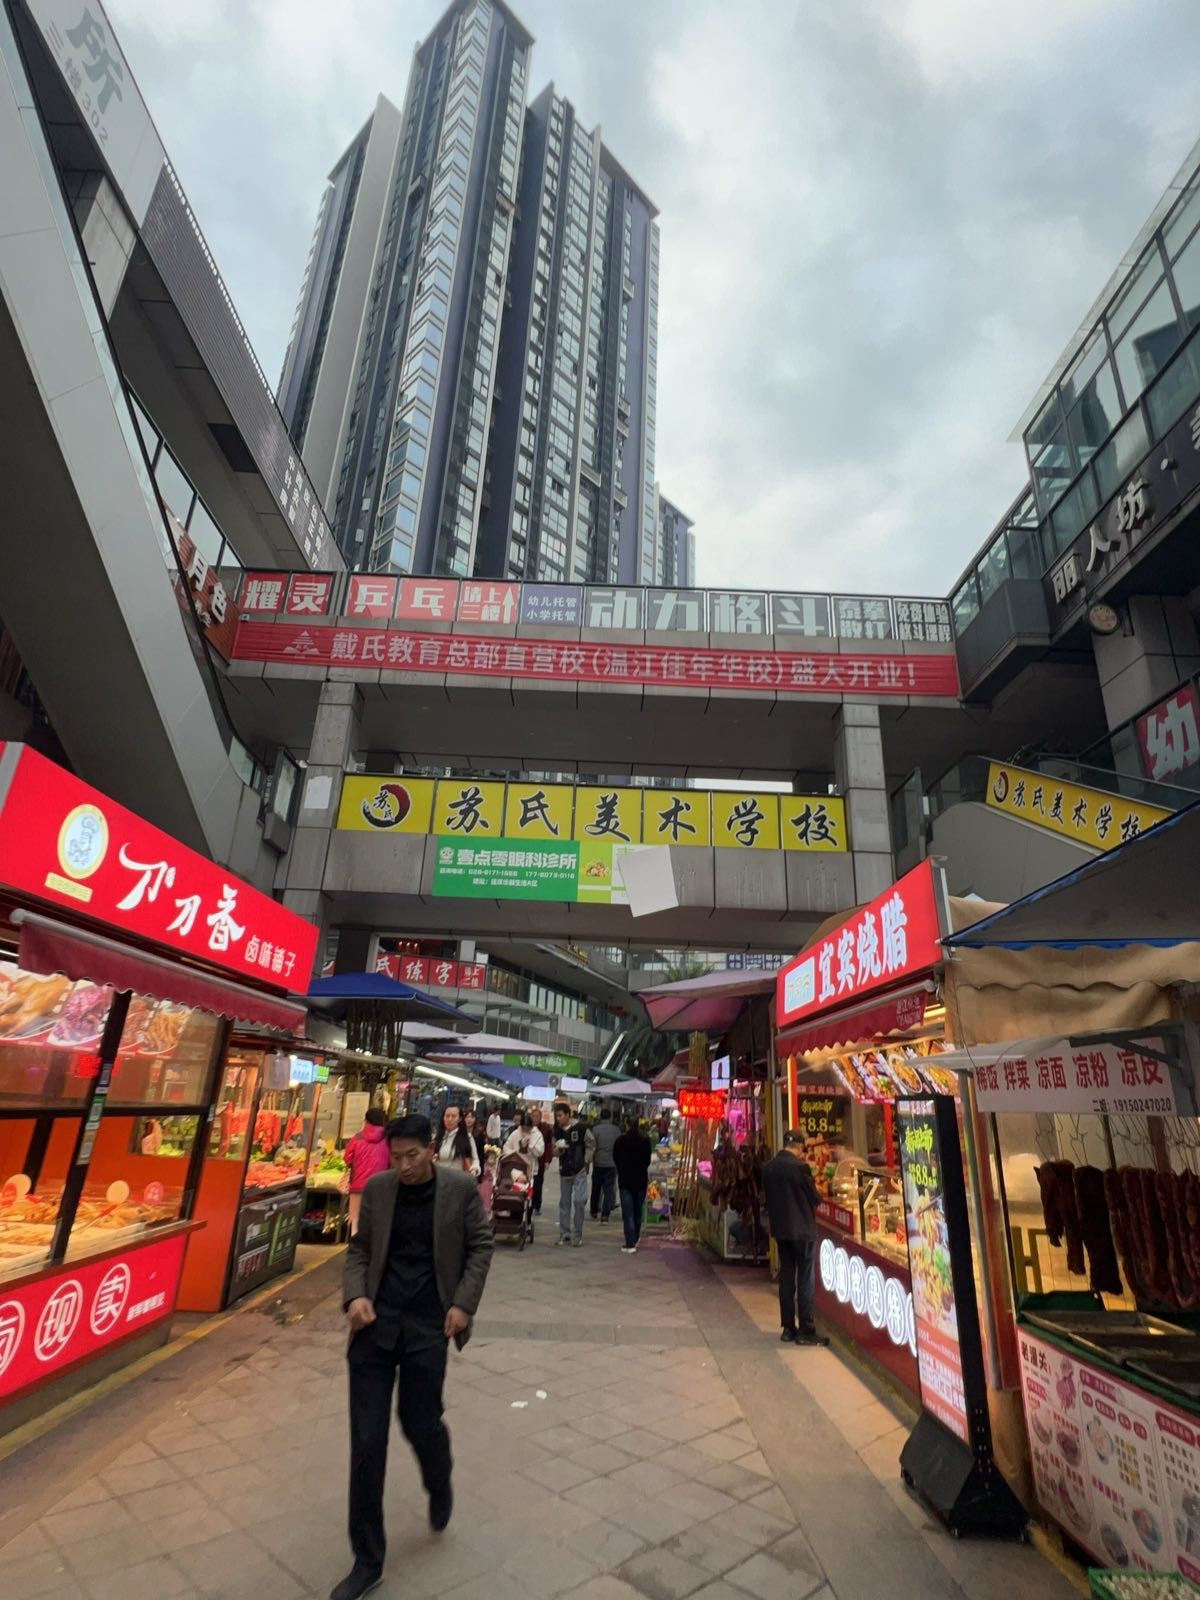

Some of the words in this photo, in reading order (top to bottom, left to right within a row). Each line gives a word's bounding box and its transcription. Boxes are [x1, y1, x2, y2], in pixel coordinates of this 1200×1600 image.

[1052, 477, 1147, 604] 丽人坊
[244, 580, 445, 617] 耀灵乒乓
[461, 604, 500, 621] 三楼
[463, 586, 501, 604] 请上
[528, 595, 577, 608] 幼儿托管
[590, 590, 825, 637] 动力格斗
[527, 609, 577, 622] 小学托管
[445, 786, 839, 848] 苏氏美术学校
[456, 848, 578, 870] 壹点零眼科诊所
[244, 935, 297, 977] 卤味铺子
[818, 890, 908, 1005] 宜宾烧腊
[1003, 1058, 1031, 1091] 拌菜
[1035, 1056, 1068, 1091] 凉面
[1072, 1051, 1110, 1089] 凉粉
